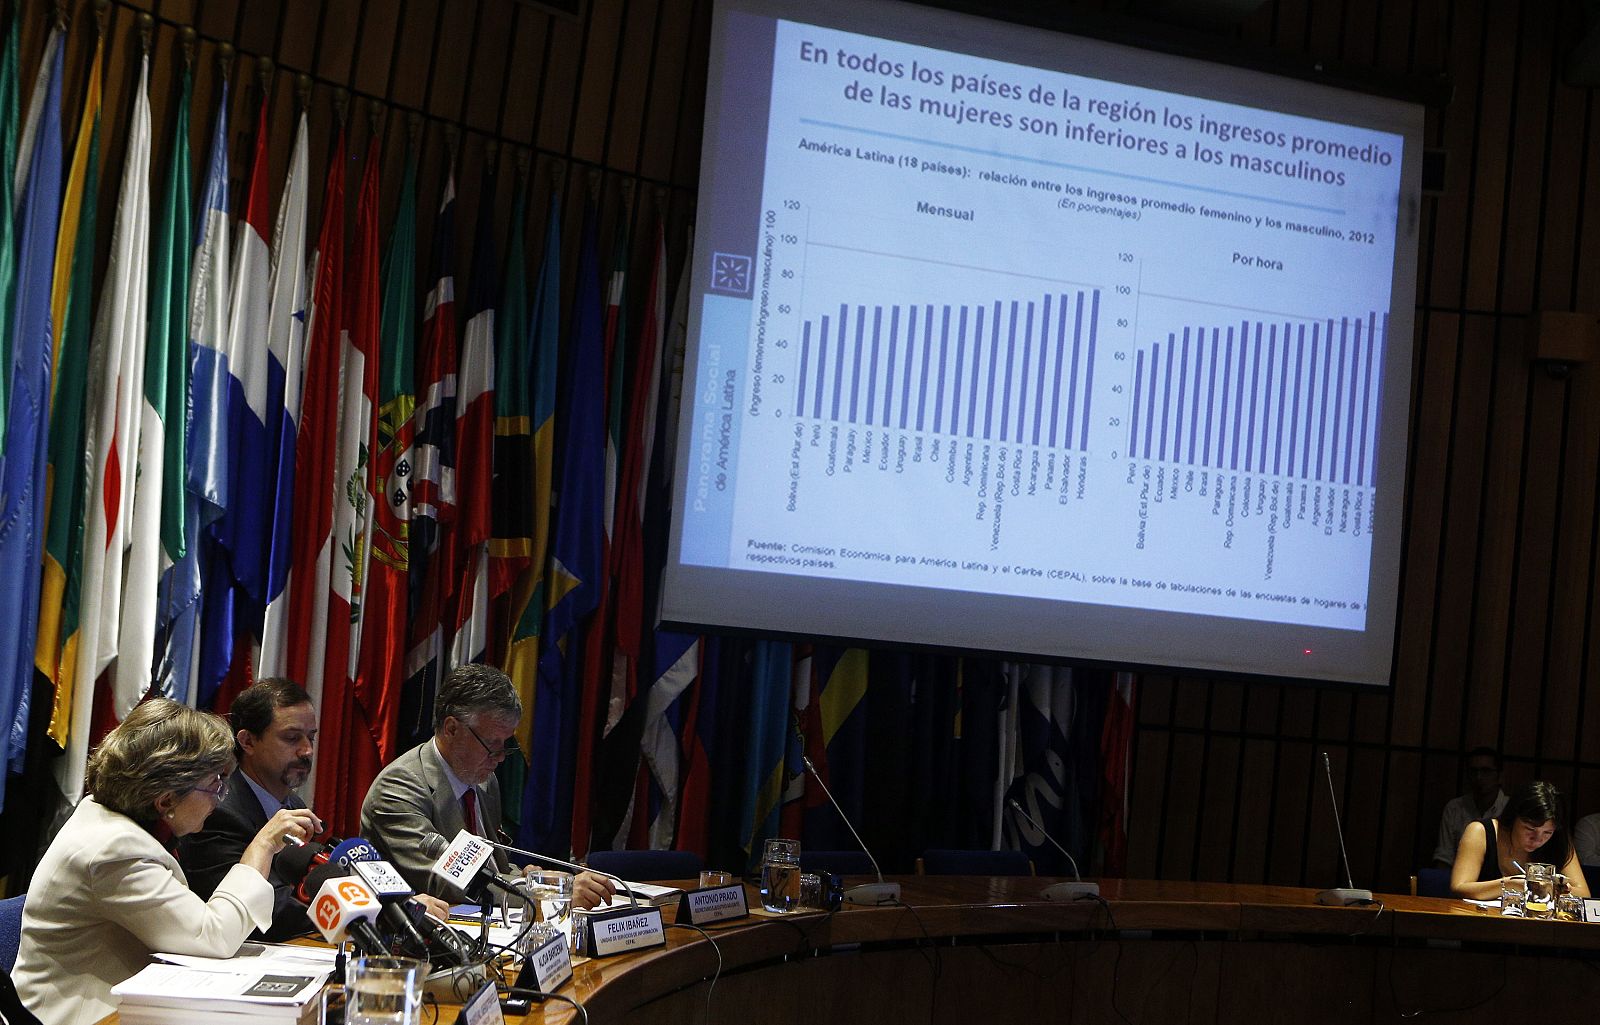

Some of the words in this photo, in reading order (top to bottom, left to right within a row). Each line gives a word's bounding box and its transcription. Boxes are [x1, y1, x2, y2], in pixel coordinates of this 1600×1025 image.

[800, 40, 828, 65] En
[837, 48, 905, 78] todos
[912, 60, 944, 86] los
[951, 73, 1022, 100] países
[1029, 84, 1056, 107] de
[1063, 88, 1081, 112] la
[1088, 98, 1156, 125] región
[1163, 107, 1193, 131] los
[1200, 114, 1286, 148] ingresos
[1291, 132, 1392, 166] promedio
[844, 81, 873, 103] de
[880, 86, 912, 111] las
[919, 96, 1013, 129] mujeres
[1019, 115, 1058, 136] son
[1065, 118, 1168, 155] inferiores
[1175, 143, 1187, 159] a
[1194, 142, 1224, 165] los
[1230, 153, 1346, 186] masculinos
[798, 137, 851, 157] América
[856, 147, 895, 165] Latina
[898, 155, 919, 169] (18
[921, 160, 971, 179] países):
[978, 169, 1027, 188] relación
[1031, 180, 1061, 193] entre
[1065, 182, 1083, 196] los
[1087, 187, 1138, 206] ingresos
[1141, 196, 1196, 215] promedio
[1200, 205, 1252, 224] femenino
[1254, 216, 1262, 228] y
[1265, 215, 1282, 230] los
[1286, 222, 1345, 241] masculino,
[1349, 230, 1375, 245] 2012
[783, 200, 800, 211] 120
[916, 201, 974, 221] Mensual
[1057, 198, 1076, 210] (En
[1077, 203, 1142, 221] porcentajes)
[780, 234, 797, 244] 100
[1118, 253, 1133, 263] 120
[1232, 252, 1254, 267] Por
[1256, 256, 1284, 272] hora
[781, 269, 794, 279] 80
[1115, 285, 1130, 295] 100
[750, 376, 764, 417] (Ingreso
[766, 210, 776, 229] 100
[778, 304, 791, 314] 60
[1117, 318, 1128, 328] 80
[775, 339, 788, 349] 40
[1114, 351, 1125, 361] 60
[704, 344, 721, 404] Social
[773, 374, 784, 384] 20
[722, 369, 736, 411] Latina
[1111, 384, 1122, 394] 40
[775, 409, 782, 418] 0
[1109, 417, 1119, 427] 20
[716, 414, 732, 470] América
[826, 426, 838, 476] Guatemala
[843, 429, 858, 473] Paraguay
[879, 432, 889, 471] Ecuador
[896, 435, 908, 474] Uruguay
[913, 436, 923, 462] Brasil
[930, 439, 940, 462] Chile
[946, 440, 957, 483] Colombia
[962, 443, 973, 486] Argentina
[1013, 449, 1022, 469] Rica
[1112, 451, 1117, 460] 0
[715, 472, 727, 491] de
[978, 445, 990, 498] Dominicana
[1011, 472, 1020, 496] Costa
[1028, 450, 1040, 496] Nicaragua
[1061, 454, 1070, 494] Salvador
[1076, 456, 1087, 499] Honduras
[1185, 470, 1194, 492] Chile
[1199, 471, 1208, 496] Brasil
[786, 481, 798, 512] Bolivia
[1155, 466, 1164, 503] Ecuador
[1212, 474, 1224, 515] Paraguay
[1256, 479, 1267, 515] Uruguay
[1059, 495, 1067, 505] El
[1226, 476, 1237, 527] Dominicana
[1241, 477, 1251, 518] Colombia
[1283, 482, 1293, 529] Guatemala
[1312, 486, 1321, 526] Argentina
[1325, 488, 1335, 525] Salvador
[1355, 491, 1363, 510] Rica
[1339, 489, 1350, 533] Nicaragua
[990, 504, 1001, 551] Venezuela
[1136, 521, 1146, 549] Bolivia
[1325, 527, 1332, 535] El
[1353, 512, 1361, 537] Costa
[746, 552, 801, 566] respectivos
[1264, 536, 1275, 580] Venezuela
[747, 539, 787, 552] Fuente:
[792, 544, 835, 556] Comisión
[840, 548, 891, 562] Económica
[895, 555, 916, 564] para
[919, 556, 957, 568] América
[962, 561, 988, 572] Latina
[993, 566, 998, 574] y
[1002, 565, 1010, 573] el
[1014, 566, 1043, 577] Caribe
[1092, 575, 1116, 585] sobre
[1120, 577, 1127, 585] la
[1131, 579, 1151, 589] base
[1156, 581, 1166, 590] de
[1170, 582, 1222, 596] tabulaciones
[1225, 588, 1236, 597] de
[1240, 589, 1252, 599] las
[1255, 592, 1296, 603] encuestas
[1300, 595, 1310, 605] de
[1314, 597, 1347, 610] hogares
[1350, 600, 1360, 610] de
[347, 844, 368, 859] BIO
[443, 851, 458, 870] radio
[447, 840, 475, 874] UNIVERSIDAD
[452, 865, 464, 878] DE
[461, 843, 481, 866] CHILE
[343, 885, 362, 901] 13
[695, 894, 718, 906] ANTONIO
[719, 891, 737, 901] PRADO
[320, 900, 335, 923] 13
[608, 921, 625, 934] FELIX
[626, 917, 648, 930] IBAÑEZ
